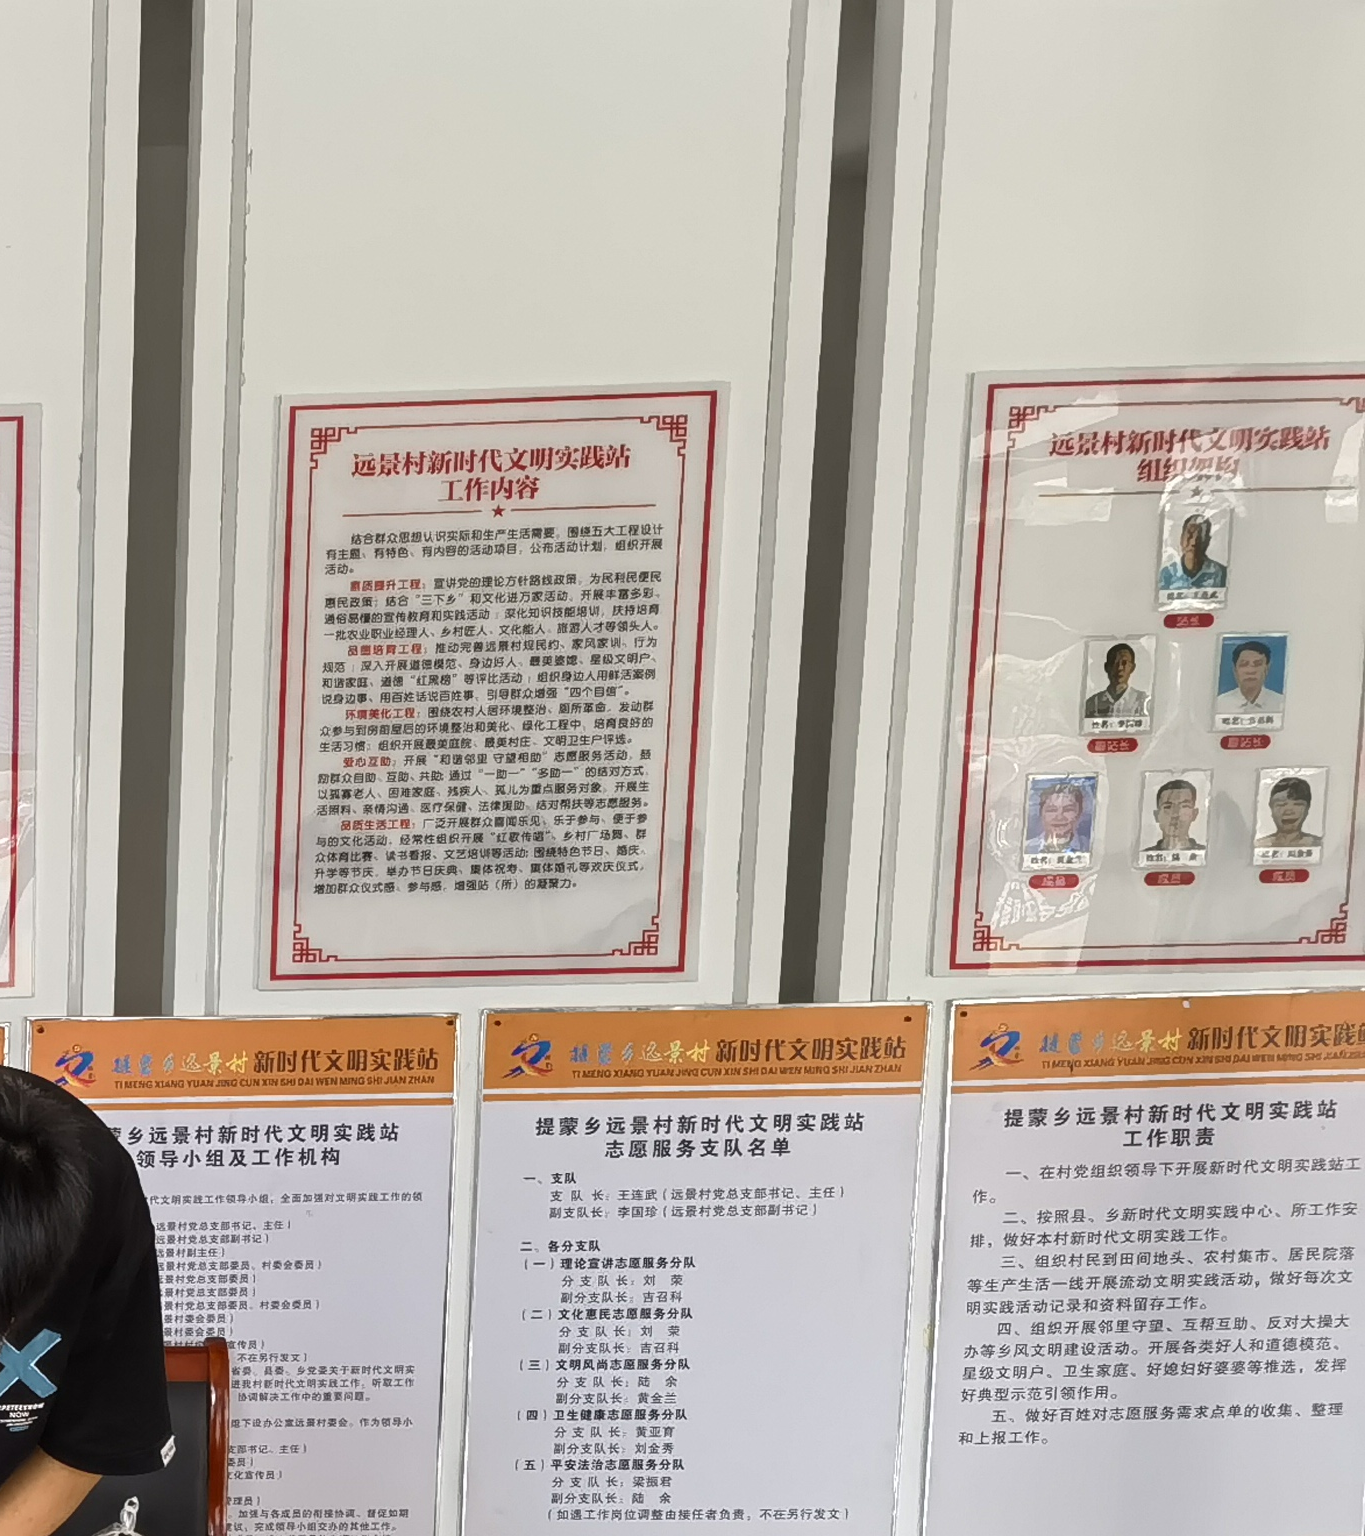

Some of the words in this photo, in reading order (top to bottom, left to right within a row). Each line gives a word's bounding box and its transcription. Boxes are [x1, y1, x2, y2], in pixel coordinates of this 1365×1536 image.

[1049, 425, 1330, 457] 远景村新时代文明实践站
[351, 444, 631, 478] 远景村新时代文明实践站
[437, 476, 540, 503] 工作内容
[253, 1048, 439, 1074] 新时代文明实践站
[715, 1037, 907, 1063] 新时代文明实践站
[187, 1078, 213, 1088] YUAN
[239, 1078, 261, 1088] CUN
[384, 1076, 407, 1085] JIAN
[407, 1075, 435, 1085] ZHAN
[535, 1112, 866, 1137] 提蒙乡远景村新时代文明实践站
[1003, 1098, 1339, 1129] 提蒙乡远景村新时代文明实践站
[604, 1136, 792, 1159] 志愿服务支队名单
[1122, 1127, 1217, 1148] 工作职责
[137, 1147, 341, 1168] 领导小组及工作机构
[523, 1171, 578, 1186] 一、支队
[972, 1189, 998, 1205] 作。
[520, 1239, 602, 1254] 二、各分支队
